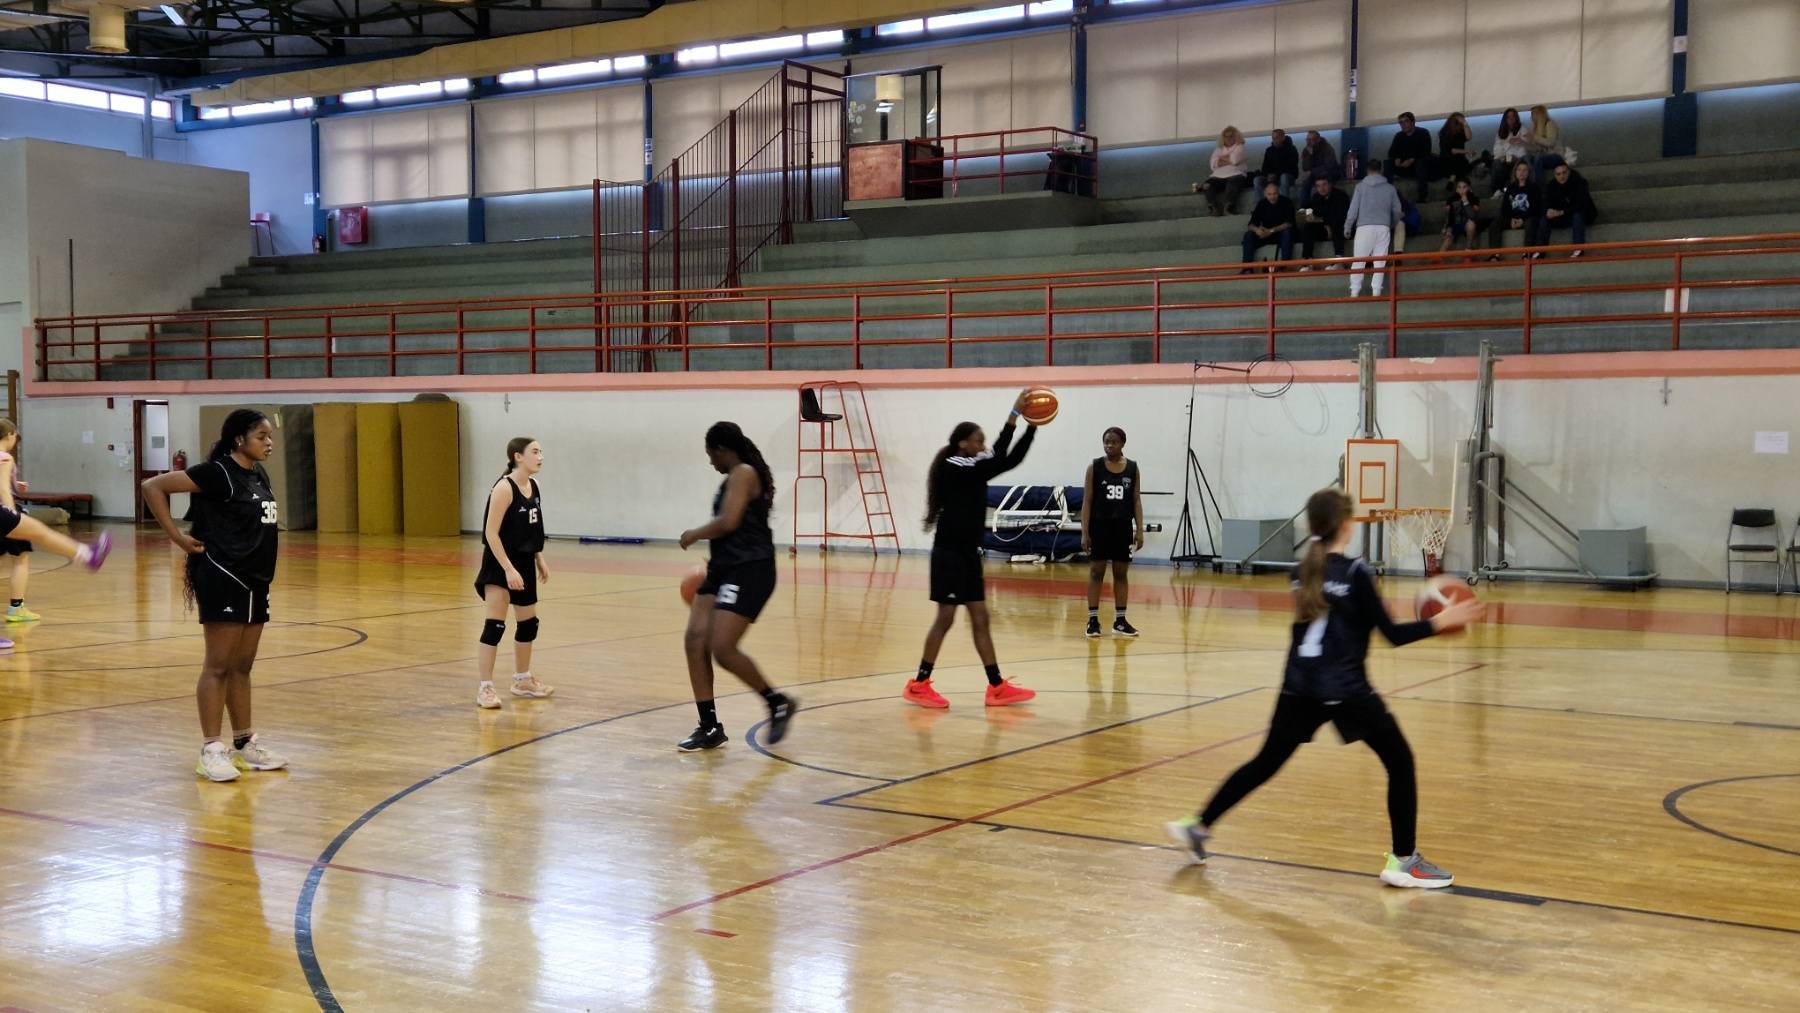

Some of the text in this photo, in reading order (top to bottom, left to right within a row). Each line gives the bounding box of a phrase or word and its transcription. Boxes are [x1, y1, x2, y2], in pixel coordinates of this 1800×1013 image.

[1106, 485, 1124, 500] 39
[260, 500, 278, 524] 36
[528, 507, 538, 524] 15
